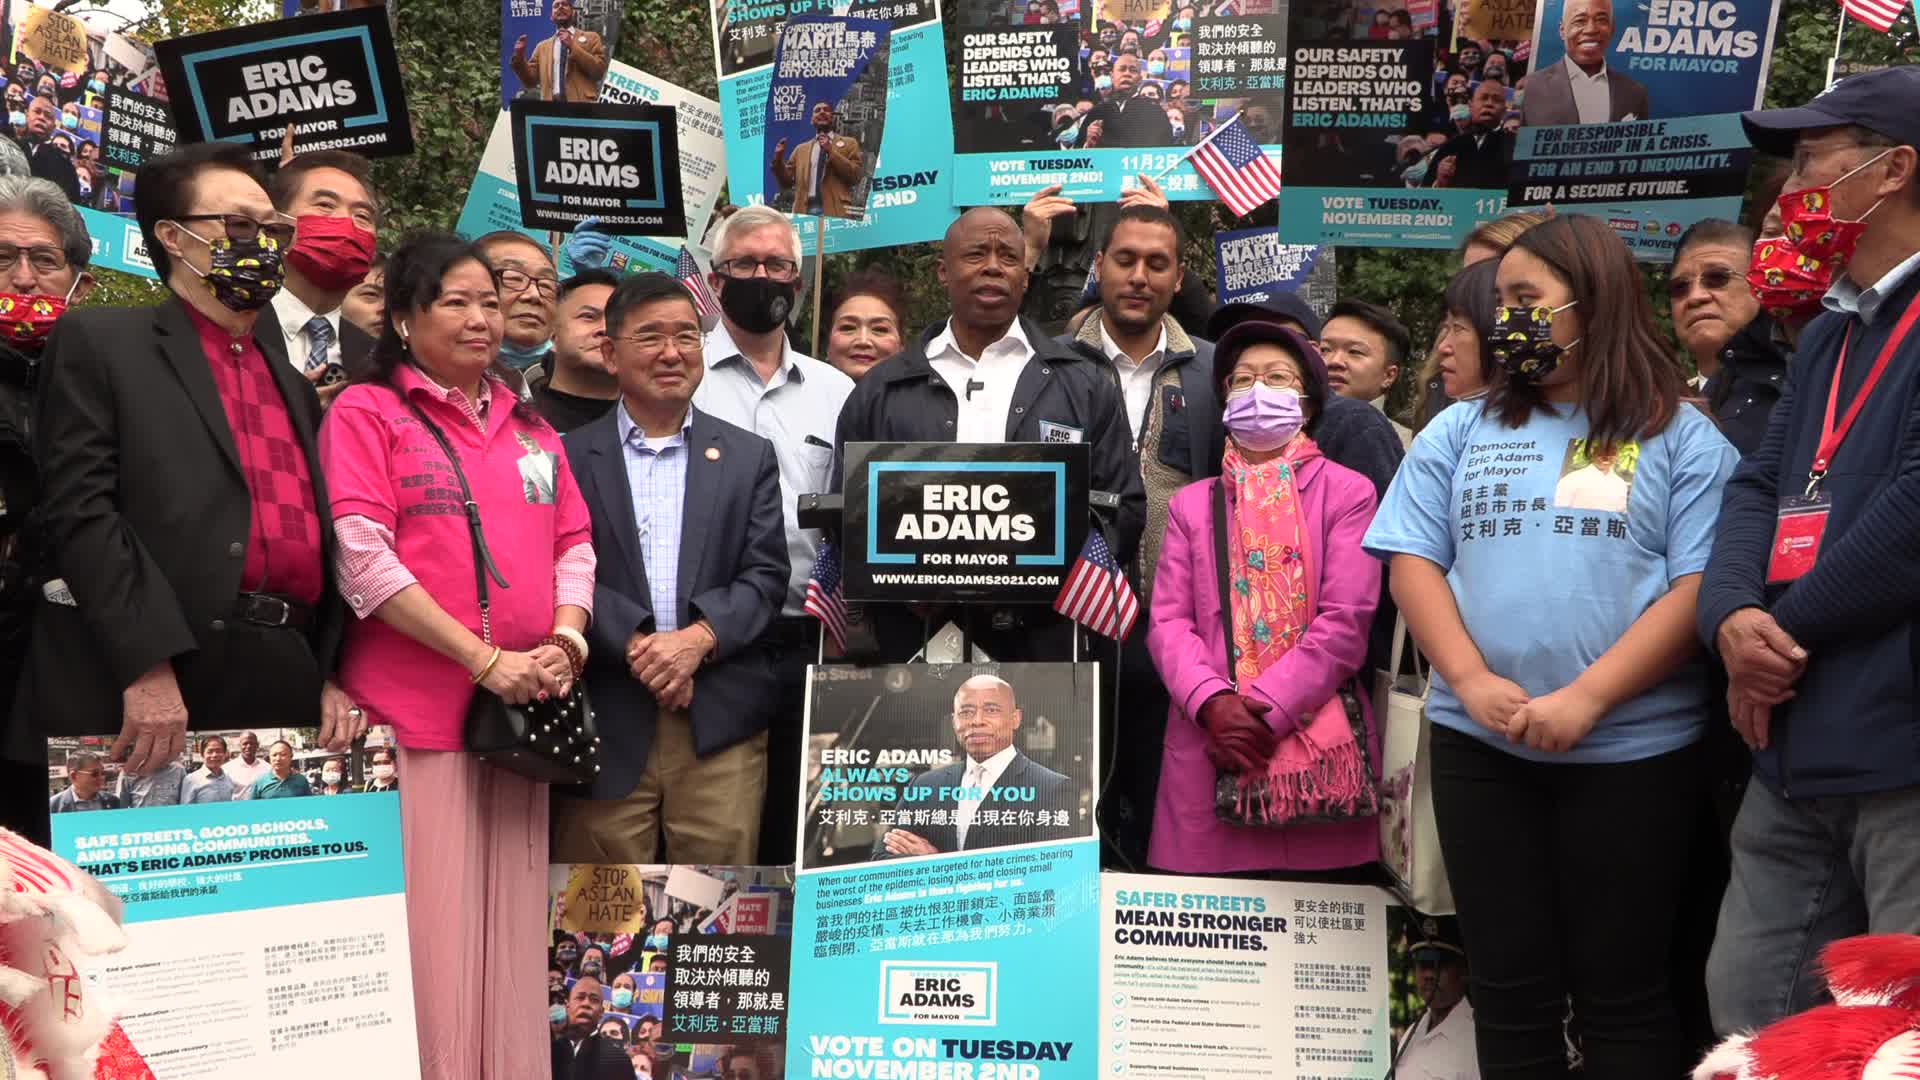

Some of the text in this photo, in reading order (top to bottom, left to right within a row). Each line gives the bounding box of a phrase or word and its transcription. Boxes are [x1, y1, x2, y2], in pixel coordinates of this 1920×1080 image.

[728, 4, 786, 24] SHOWS
[790, 0, 812, 14] UP
[1649, 0, 1737, 29] ERIC
[48, 13, 76, 32] STOP
[785, 22, 846, 35] CHRISTOPHER
[1198, 24, 1264, 39] 我們的安全
[34, 25, 81, 49] ASIAN
[783, 31, 845, 50] MARTE
[963, 31, 1054, 47] OUR SAFETY
[1616, 27, 1758, 58] ADAMS
[44, 43, 79, 64] HATE
[963, 44, 1057, 60] DEPENDS ON
[1198, 40, 1277, 56] 取決於傾聽的
[1295, 48, 1405, 63] OUR SAFETY
[242, 55, 327, 91] ERIC
[779, 67, 848, 78] CITY COUNCIL
[780, 58, 855, 71] DEMOCRAT FOR
[963, 57, 1071, 74] LEADERS WHO
[1294, 65, 1407, 79] DEPENDS ON
[1629, 56, 1738, 74] FOR MAYOR
[963, 71, 1072, 87] LISTEN. THAT'S
[773, 85, 803, 96] VOTE
[962, 86, 1059, 101] ERIC ADAMS!
[1293, 81, 1422, 96] LEADERS WHO
[111, 93, 167, 123] 我們的安全
[228, 79, 357, 123] ADAMS
[773, 94, 806, 105] NOV 2
[1292, 97, 1422, 113] LISTEN. THAT'S
[1292, 113, 1408, 128] ERIC ADAMS!
[260, 120, 338, 141] FOR MAYOR
[1535, 122, 1667, 142] FOR RESPONSIBLE
[560, 137, 619, 163] ERIC
[1532, 133, 1712, 157] LEADERSHIP IN A CRISIS.
[989, 160, 1026, 172] VOTE
[1529, 153, 1732, 177] FOR AN END TO INEQUALITY.
[545, 161, 640, 188] ADAMS
[990, 171, 1104, 187] NOVEMBER 2ND!
[873, 190, 917, 209] 2ND
[1524, 180, 1689, 201] FOR A SECURE FUTURE.
[563, 195, 621, 208] FOR MAYOR
[1321, 197, 1443, 212] VOTE TUESDAY,
[1322, 212, 1453, 227] NOVEMBER 2ND!
[1050, 428, 1070, 440] ERIC
[1470, 440, 1536, 455] Democrat
[1467, 452, 1544, 468] Eric Adams
[1464, 465, 1528, 482] for Mayor
[923, 484, 1010, 512] ERIC
[1462, 483, 1509, 504] 民主黨
[1461, 497, 1547, 520] 紐約市市長
[895, 514, 1036, 542] ADAMS
[923, 553, 1008, 566] FOR MAYOR
[872, 573, 1060, 586] WWW.ERICADAMS2021.COM
[821, 749, 953, 765] ERIC ADAMS
[819, 767, 910, 784] ALWAYS
[819, 786, 1036, 802] SHOWS UP FOR YOU
[75, 818, 329, 850] SAFE STREETS, GOOD SCHOOLS,
[76, 832, 312, 863] AND STRONG COMMUNITIES.
[141, 858, 180, 873] ERIC
[182, 851, 248, 868] ADAMS'
[249, 844, 321, 862] PROMISE
[323, 842, 346, 855] TO
[347, 840, 369, 854] US.
[591, 867, 629, 886] STOP
[818, 876, 843, 887] When
[843, 876, 856, 884] our
[858, 868, 914, 882] communities
[916, 866, 930, 875] are
[932, 861, 968, 874] targeted
[970, 860, 983, 869] for
[985, 857, 1004, 867] hate
[1040, 848, 1073, 860] bearing
[817, 889, 830, 898] the
[833, 885, 856, 897] worst
[869, 882, 882, 892] the
[928, 873, 954, 886] losing
[978, 868, 994, 879] and
[996, 864, 1027, 877] closing
[1029, 862, 1052, 873] small
[576, 886, 635, 902] ASIAN
[1115, 890, 1266, 913] SAFER STREETS
[588, 902, 634, 923] HATE
[1293, 898, 1365, 916] 更安全的街道
[1115, 909, 1287, 933] MEAN STRONGER
[1294, 915, 1365, 932] 可以使社區更
[1115, 928, 1268, 951] COMMUNITIES.
[1294, 931, 1317, 945] 強大
[676, 945, 755, 964] 我們的安全
[674, 967, 770, 986] 取決於傾聽的
[915, 978, 961, 992] ERIC
[900, 993, 975, 1008] ADAMS
[809, 1036, 1073, 1061] VOTE ON TUESDAY
[811, 1058, 1040, 1080] NOVEMBER 2ND
